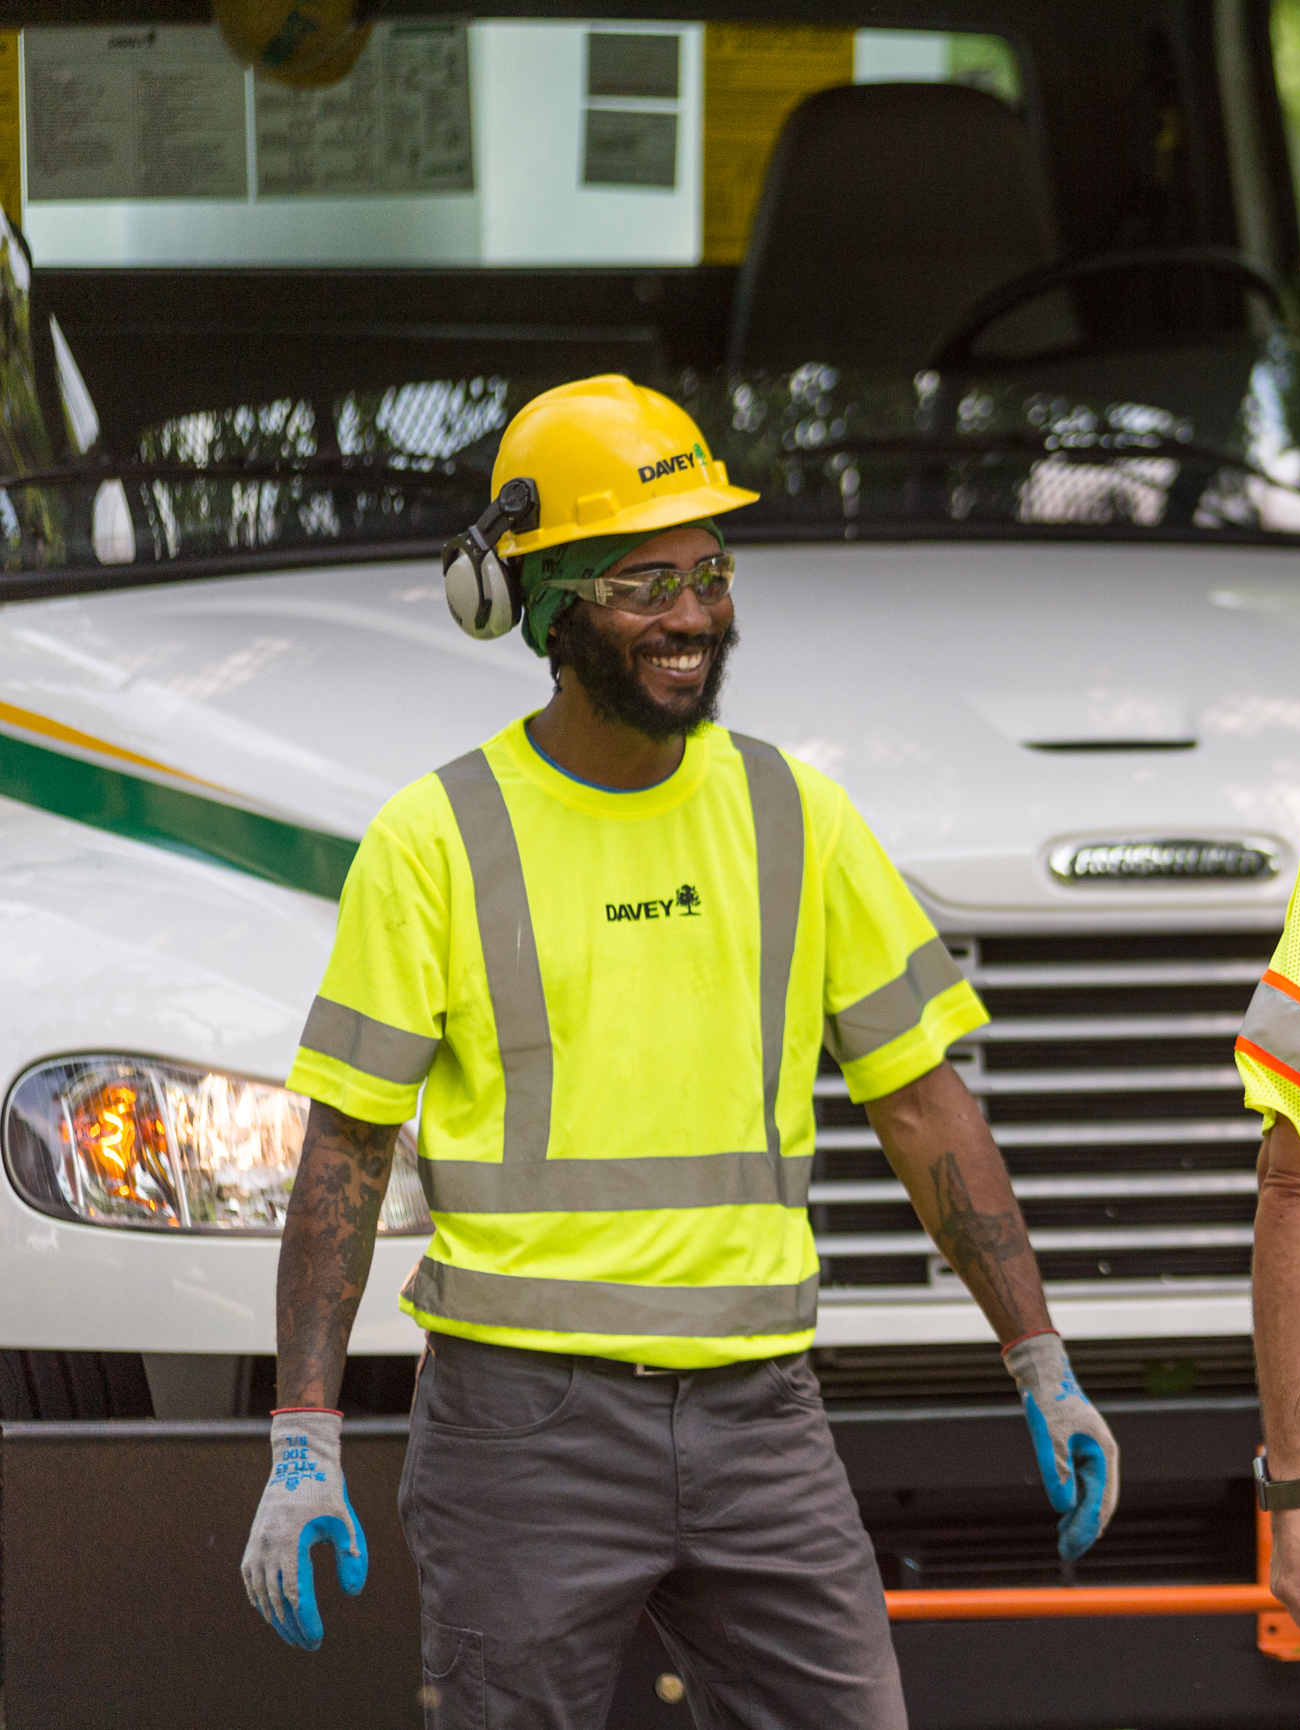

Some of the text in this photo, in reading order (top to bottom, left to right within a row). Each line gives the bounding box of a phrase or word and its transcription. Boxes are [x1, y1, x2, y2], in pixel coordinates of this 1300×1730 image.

[637, 452, 695, 484] DAVEY
[605, 899, 674, 922] DAVEY
[283, 1447, 309, 1461] 300
[276, 1460, 317, 1475] ATLAS
